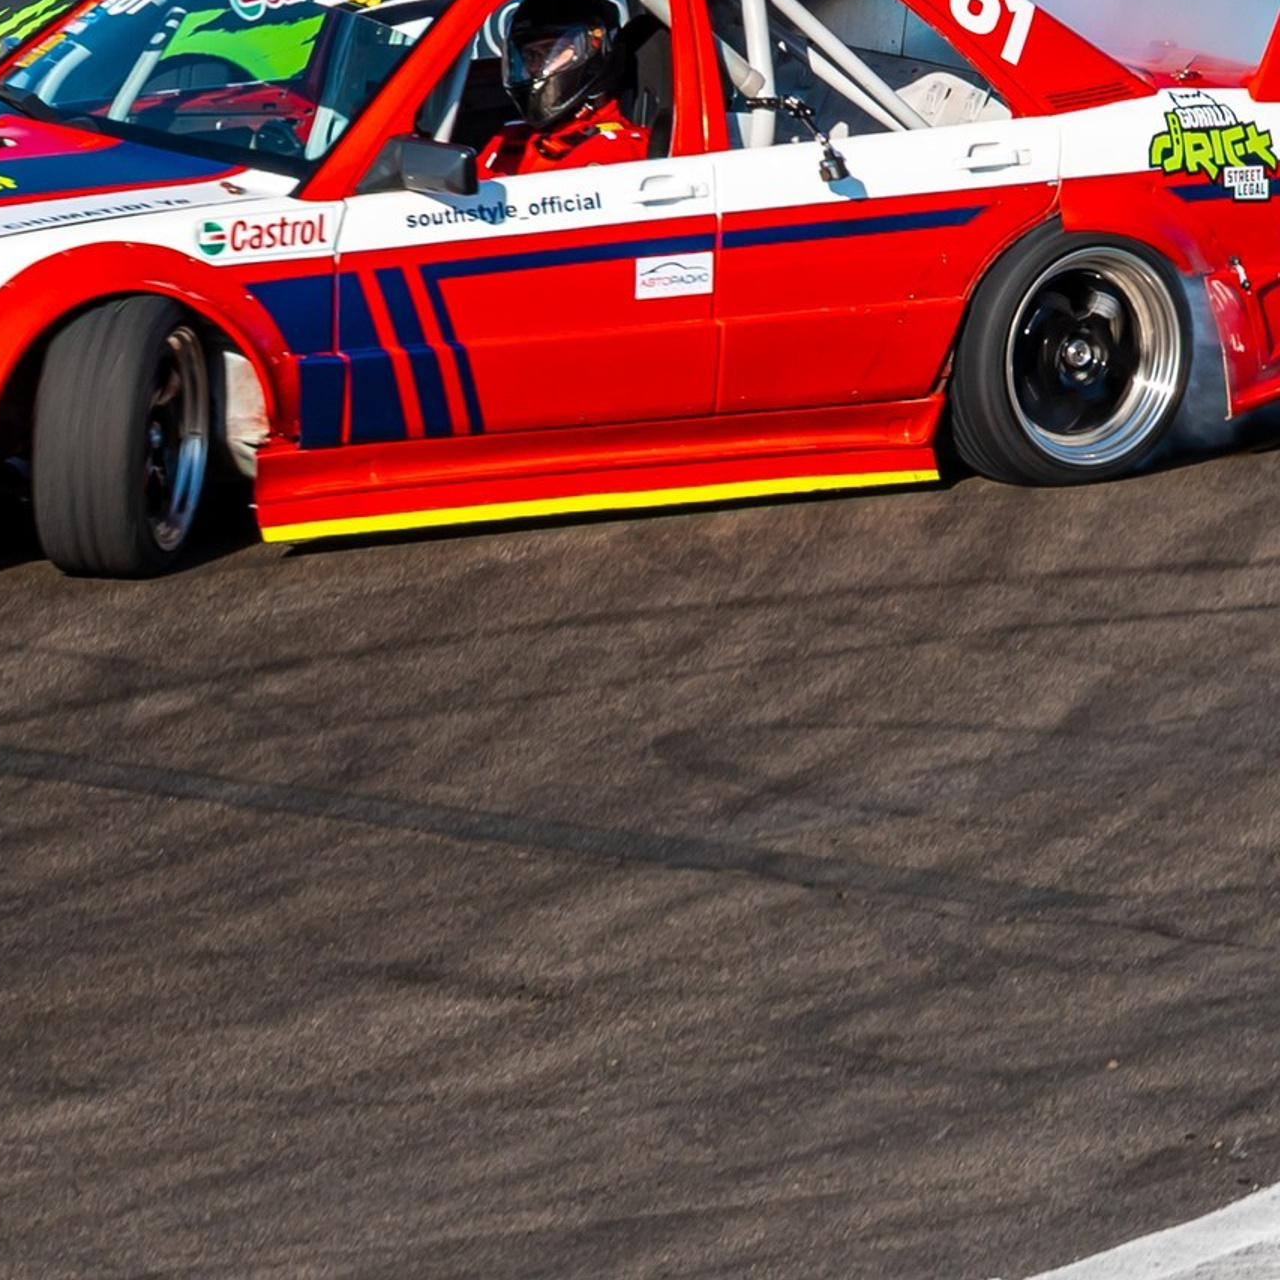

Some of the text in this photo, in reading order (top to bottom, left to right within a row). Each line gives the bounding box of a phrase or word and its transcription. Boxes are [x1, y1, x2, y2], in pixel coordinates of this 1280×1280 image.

[1175, 106, 1237, 129] GORILLA
[1227, 169, 1261, 184] STREET
[1237, 183, 1266, 196] LEGAL
[406, 191, 603, 230] southstyle_official
[230, 212, 328, 255] Castrol
